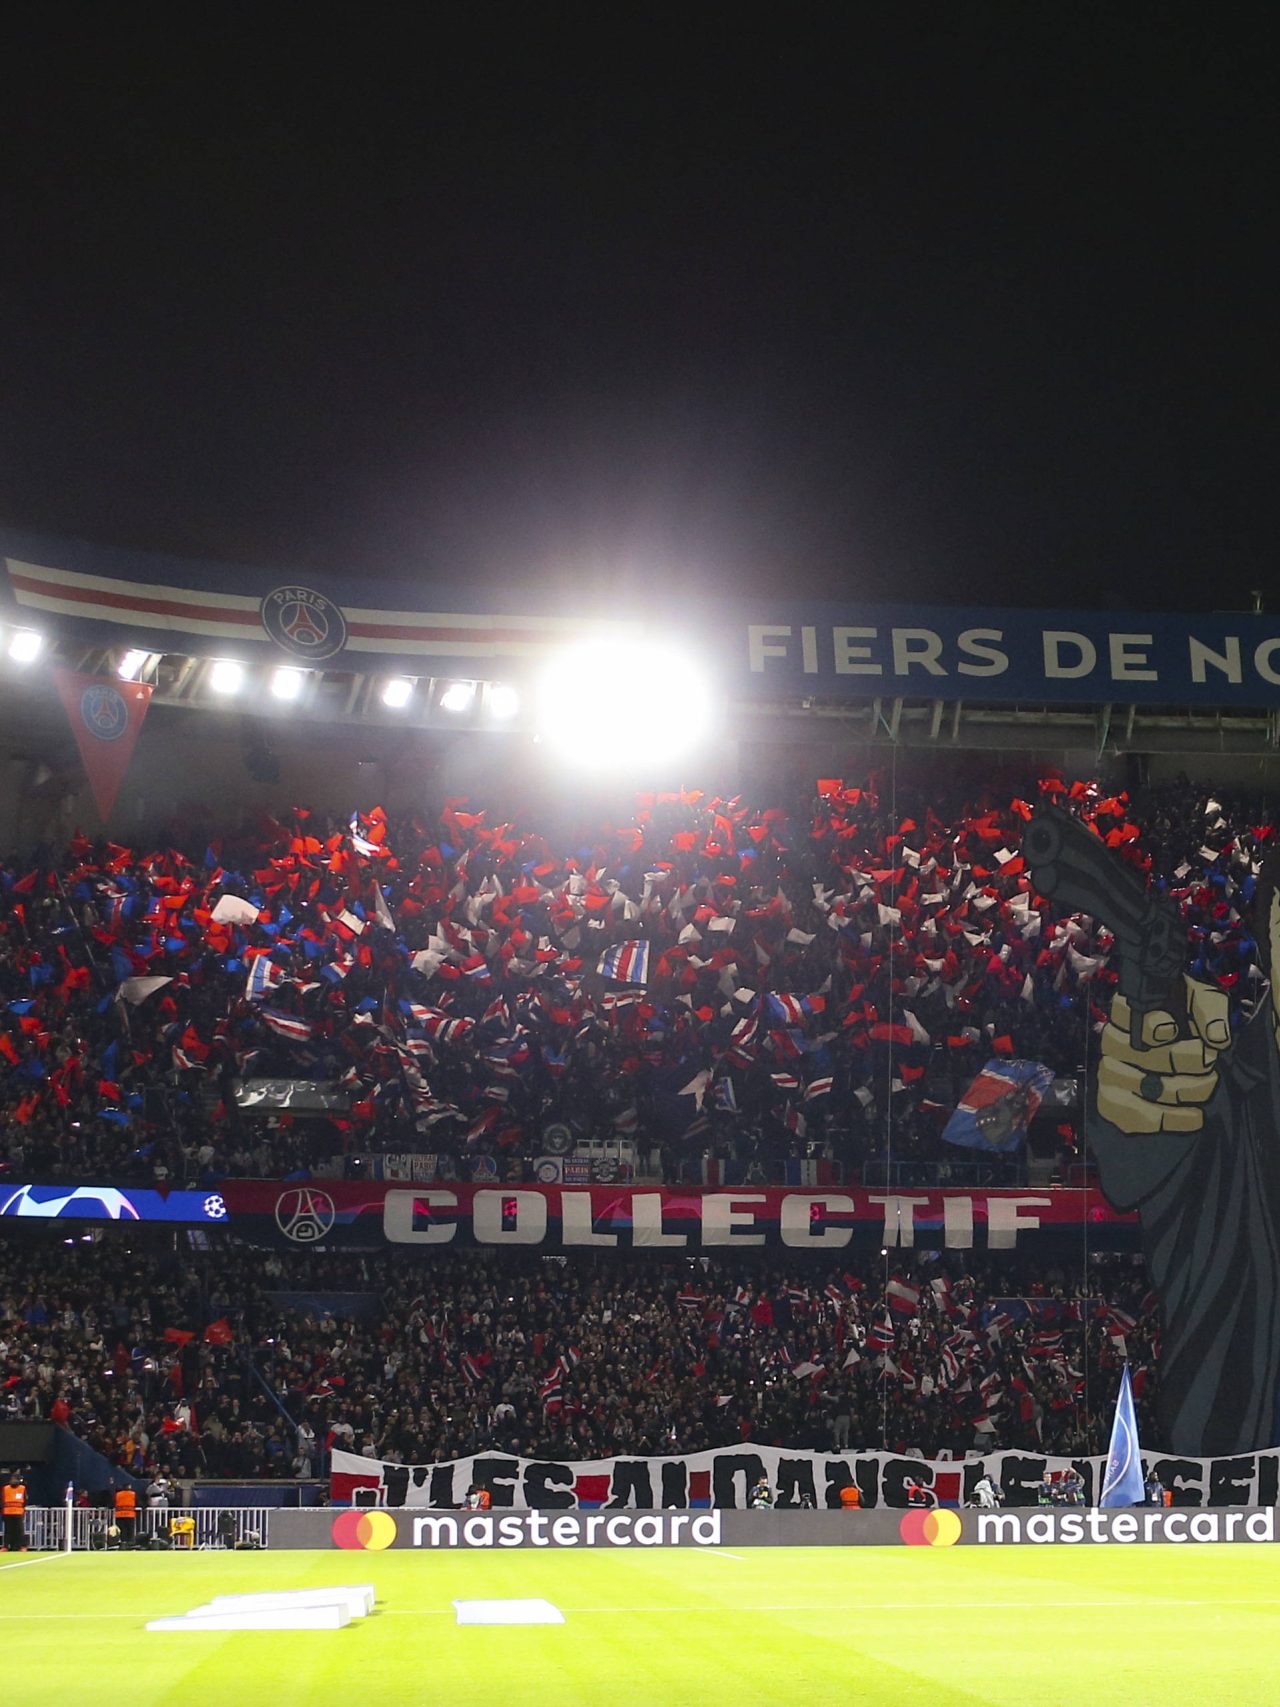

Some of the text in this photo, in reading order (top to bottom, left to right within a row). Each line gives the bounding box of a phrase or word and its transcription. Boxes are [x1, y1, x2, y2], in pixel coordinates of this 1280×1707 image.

[273, 589, 328, 610] PARIS
[748, 624, 1010, 678] FIERS
[1042, 629, 1158, 682] DE
[383, 1188, 1052, 1250] COLLECTIF
[412, 1508, 721, 1547] mastercard
[978, 1506, 1274, 1543] mastercard
